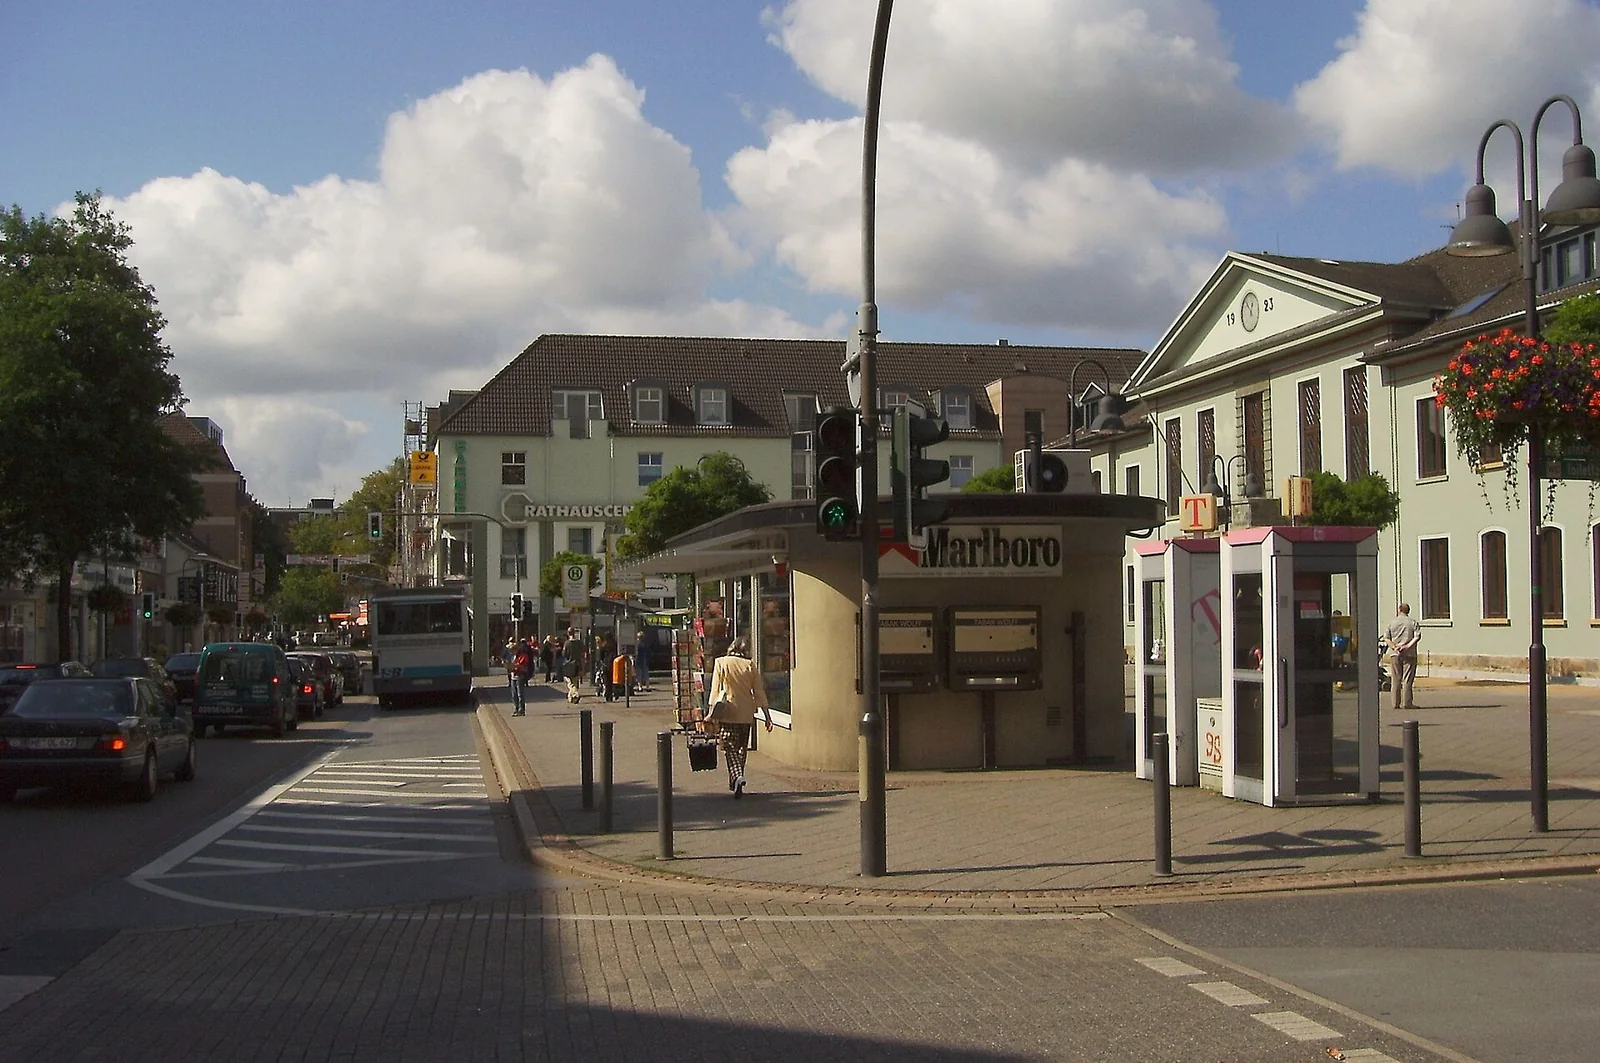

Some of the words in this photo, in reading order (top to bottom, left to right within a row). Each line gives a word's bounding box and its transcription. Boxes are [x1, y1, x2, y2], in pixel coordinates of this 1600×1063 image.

[1226, 312, 1235, 326] 19
[1263, 297, 1274, 312] 23
[1184, 498, 1207, 527] T
[920, 527, 1061, 568] Marlboro
